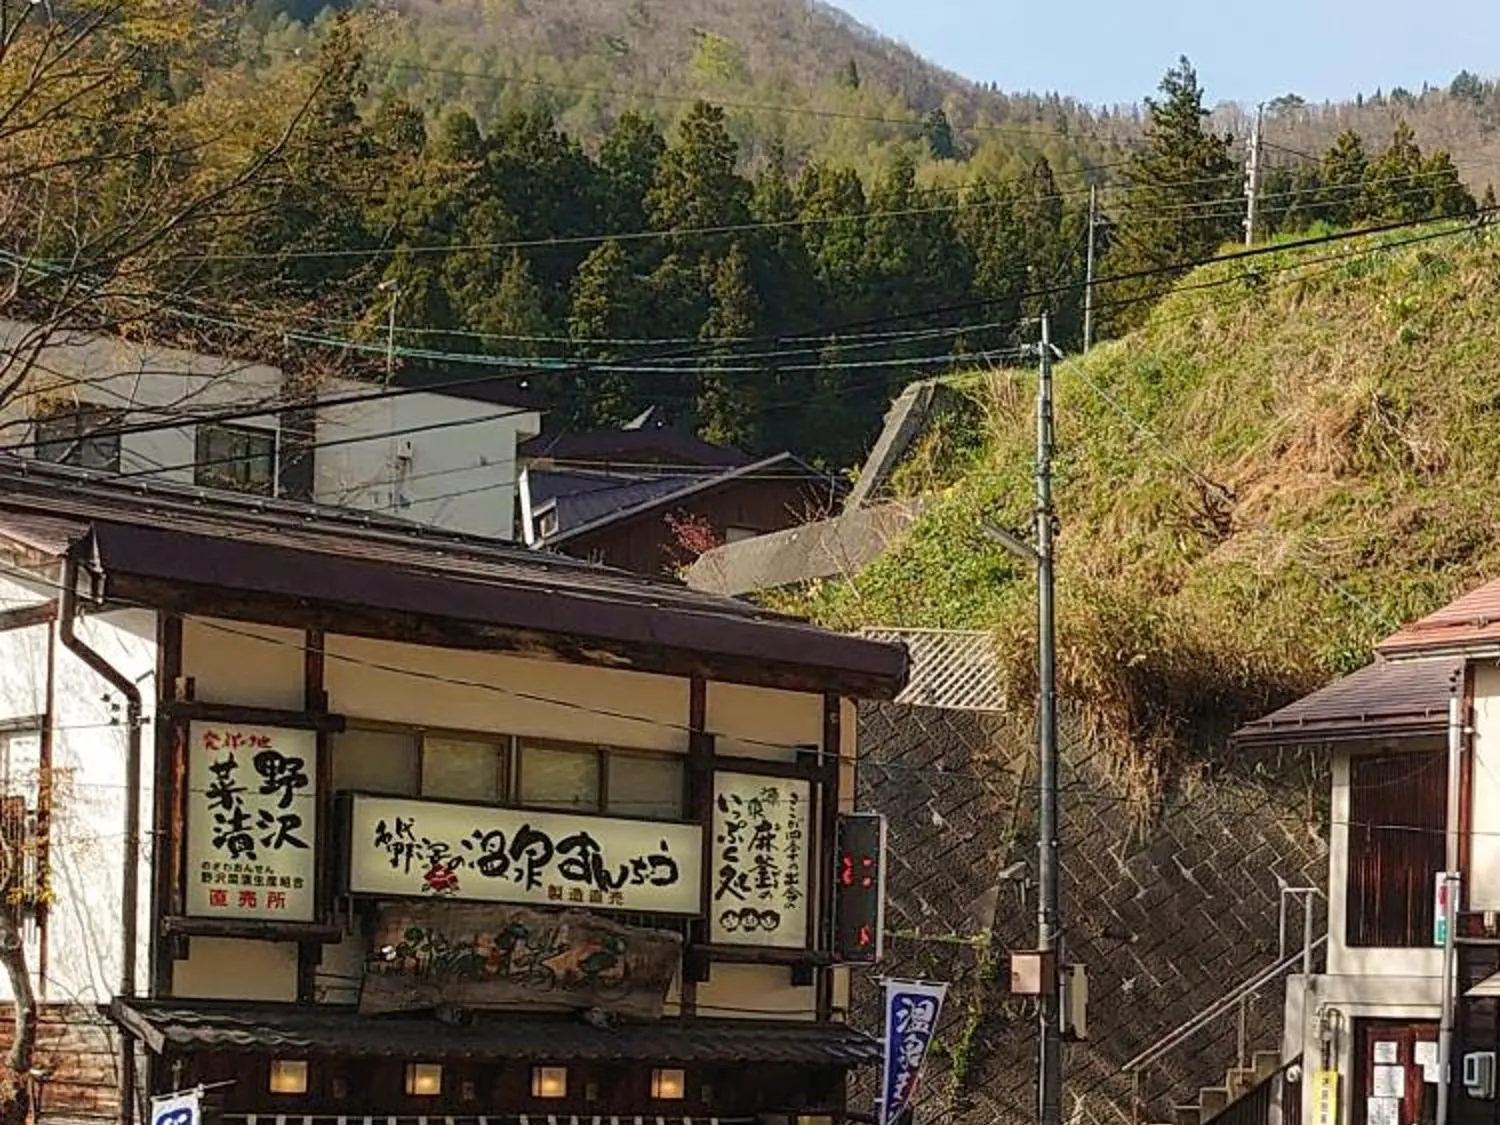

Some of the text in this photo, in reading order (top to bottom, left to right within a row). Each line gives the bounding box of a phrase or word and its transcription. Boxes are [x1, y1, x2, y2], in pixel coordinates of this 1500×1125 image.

[253, 750, 311, 849] 野沢
[209, 889, 286, 910] 直売所
